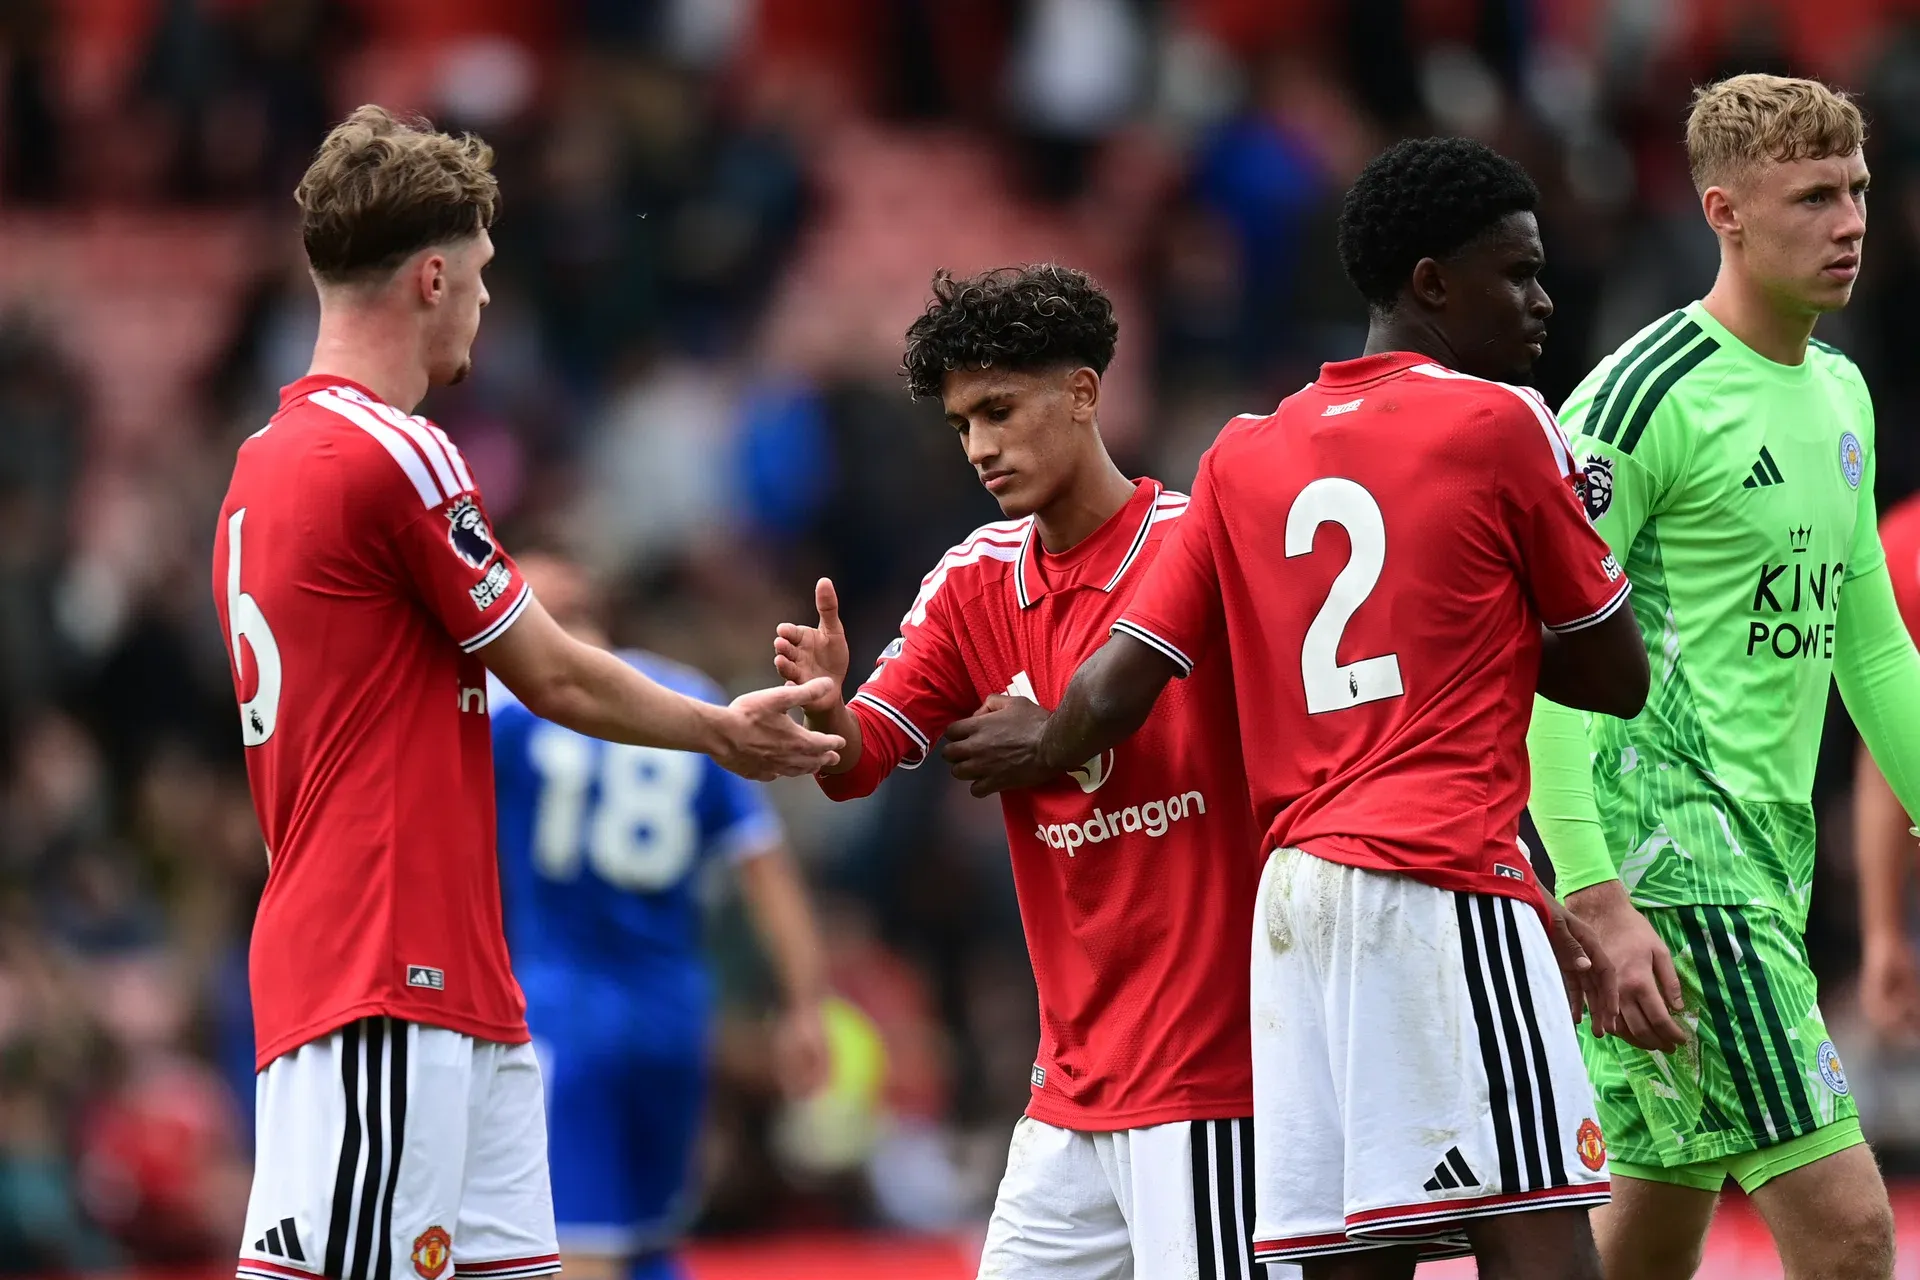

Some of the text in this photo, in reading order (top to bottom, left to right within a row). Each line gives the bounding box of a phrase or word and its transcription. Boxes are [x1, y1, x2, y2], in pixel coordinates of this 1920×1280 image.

[227, 507, 283, 747] 6
[1285, 477, 1405, 716] 2
[1746, 621, 1835, 659] POWE
[1752, 562, 1844, 612] KING
[528, 722, 704, 892] 18
